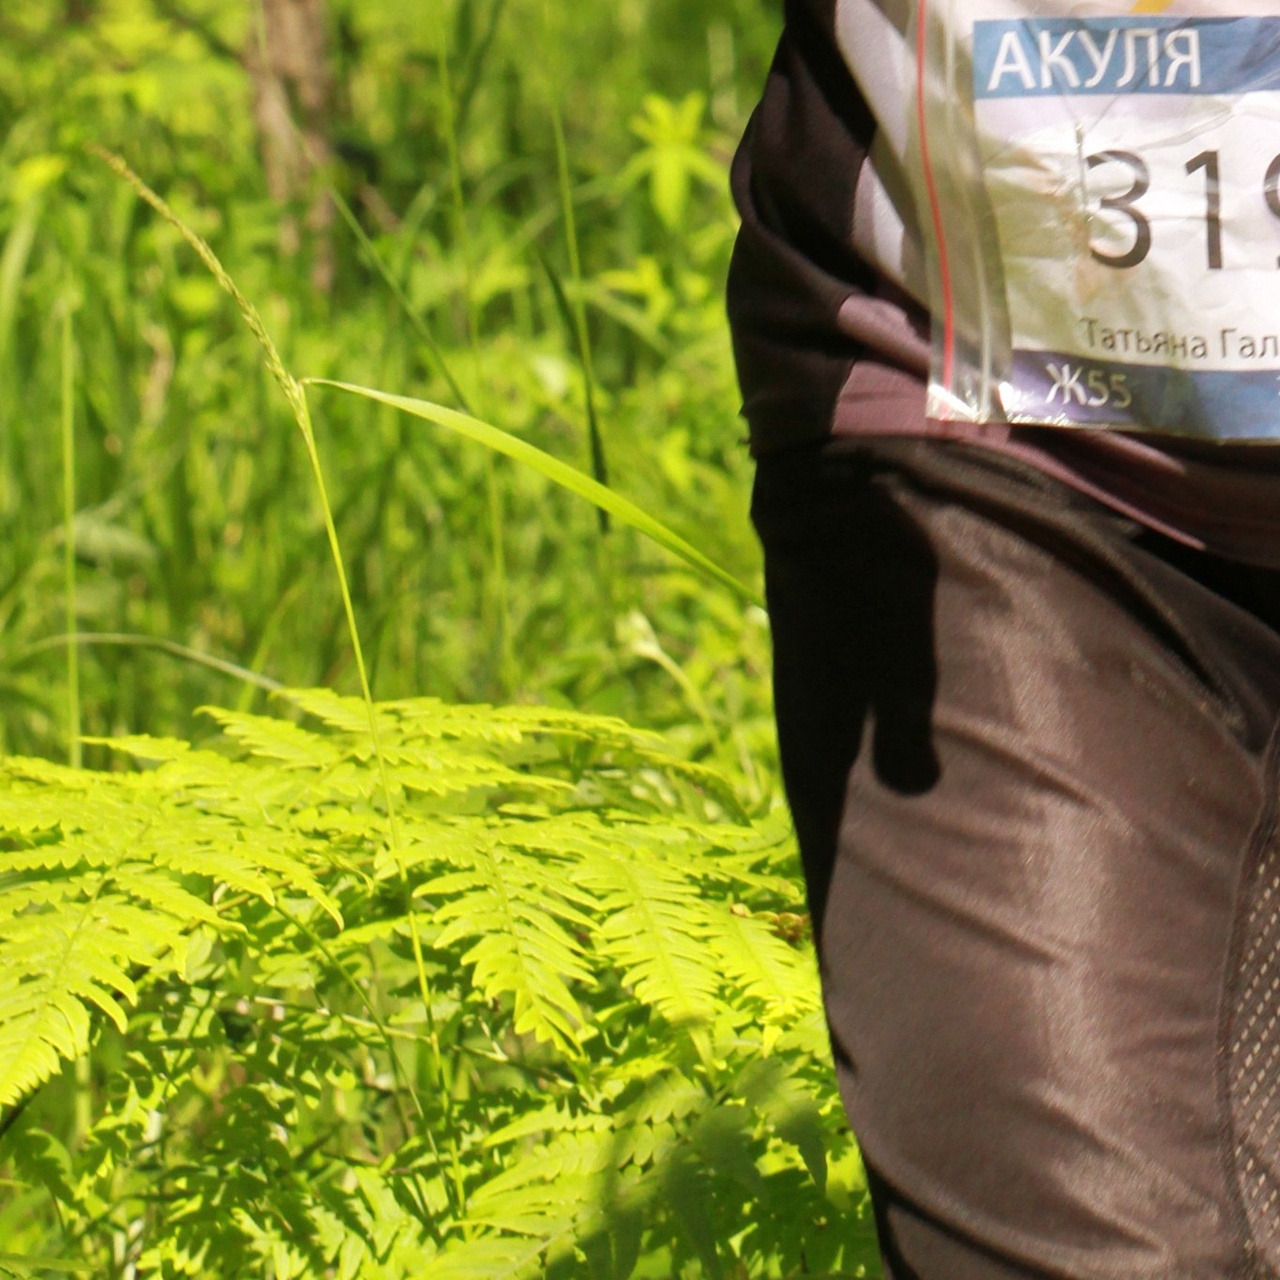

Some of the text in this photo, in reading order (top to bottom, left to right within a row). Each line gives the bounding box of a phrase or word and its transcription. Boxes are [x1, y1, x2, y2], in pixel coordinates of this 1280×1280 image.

[986, 27, 1203, 91] АКУЛЯ
[1079, 316, 1208, 359] Татьяна
[1045, 362, 1133, 409] Ж55
